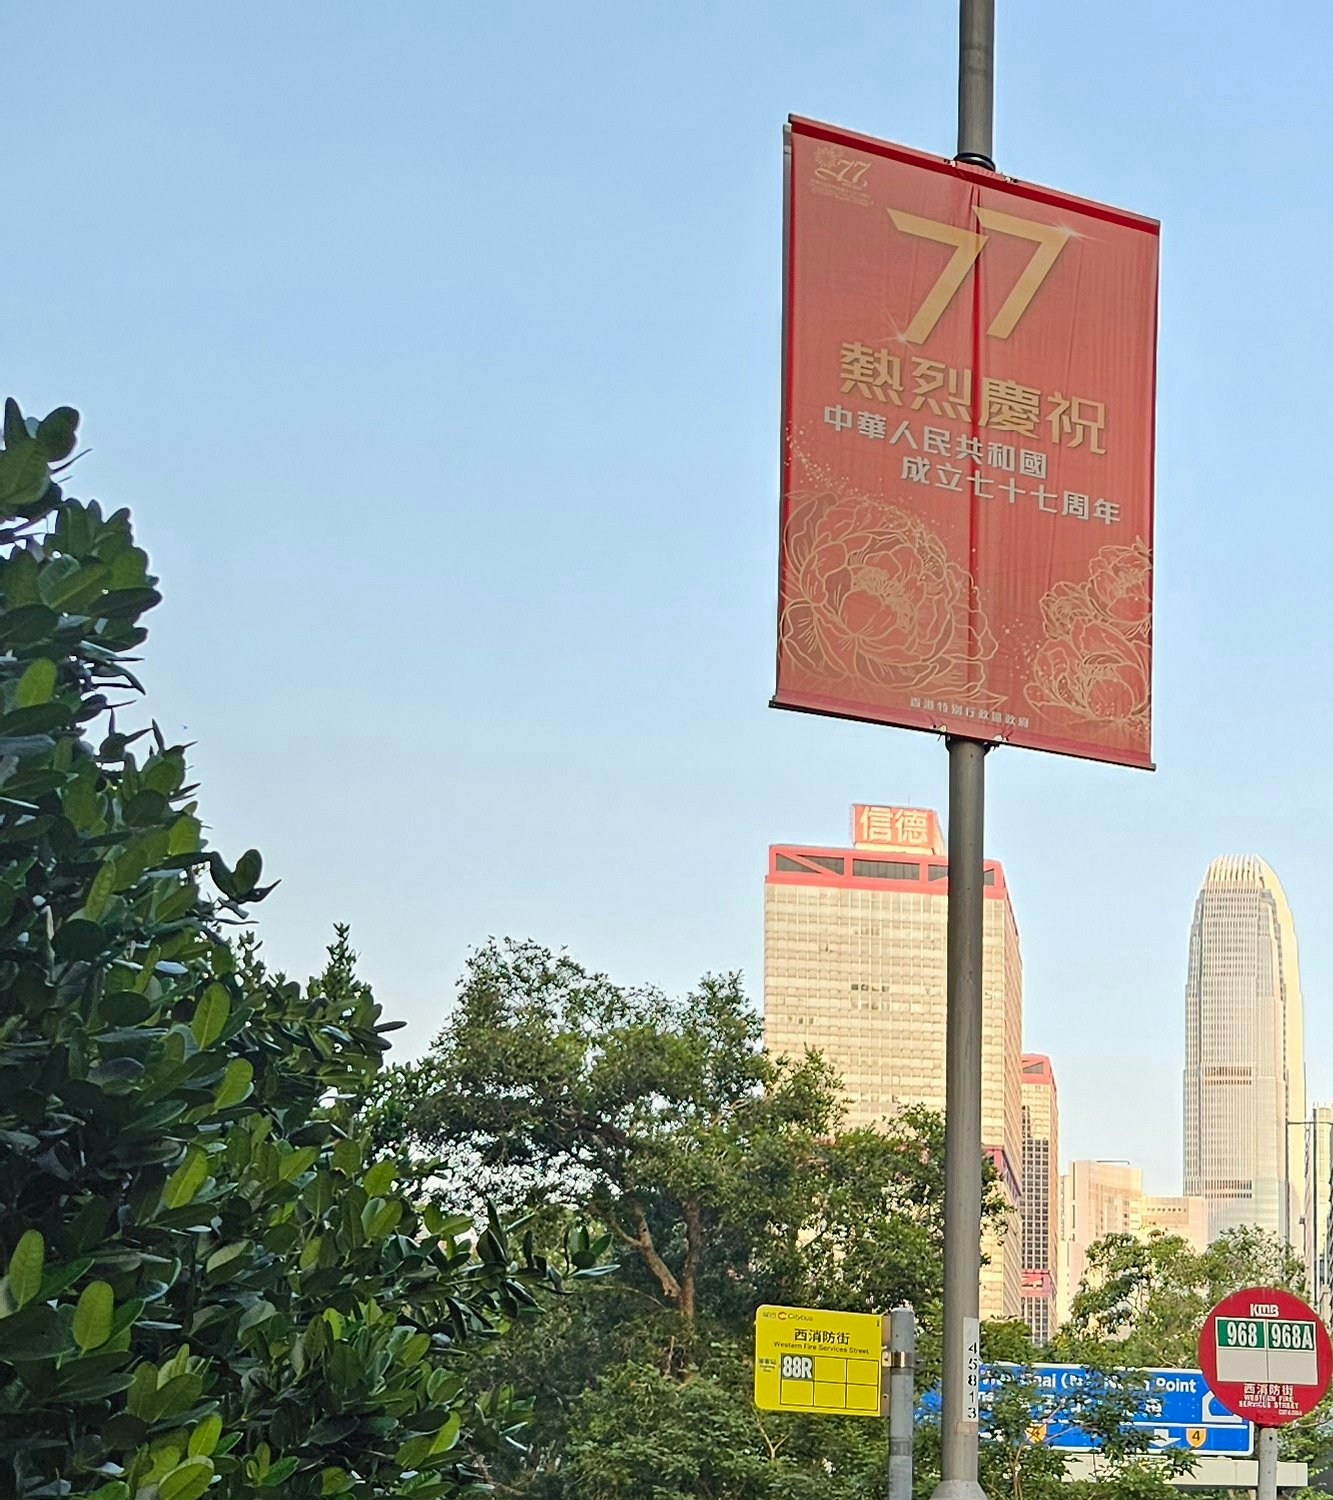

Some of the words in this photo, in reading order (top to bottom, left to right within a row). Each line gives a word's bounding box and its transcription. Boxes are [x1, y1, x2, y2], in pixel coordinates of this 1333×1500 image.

[886, 206, 1072, 345] 77
[839, 341, 1107, 455] 熱烈慶祝
[823, 404, 1048, 481] 中華人民共和國
[901, 457, 1122, 526] 成立七十七周年
[911, 697, 1029, 728] 香港特別行政區政府
[860, 806, 928, 844] 信德
[1250, 1303, 1279, 1317] KMB
[774, 1341, 802, 1349] Western
[804, 1343, 817, 1351] Fire
[818, 1344, 847, 1353] Services
[849, 1346, 869, 1355] Street
[794, 1328, 850, 1345] 西消防街
[1227, 1322, 1257, 1346] 968
[1271, 1324, 1313, 1349] 968A
[782, 1355, 813, 1379] 88R
[968, 1341, 978, 1419] 45813
[1156, 1377, 1196, 1394] Point
[1244, 1383, 1293, 1396] 西消防街
[1191, 1431, 1201, 1441] 4
